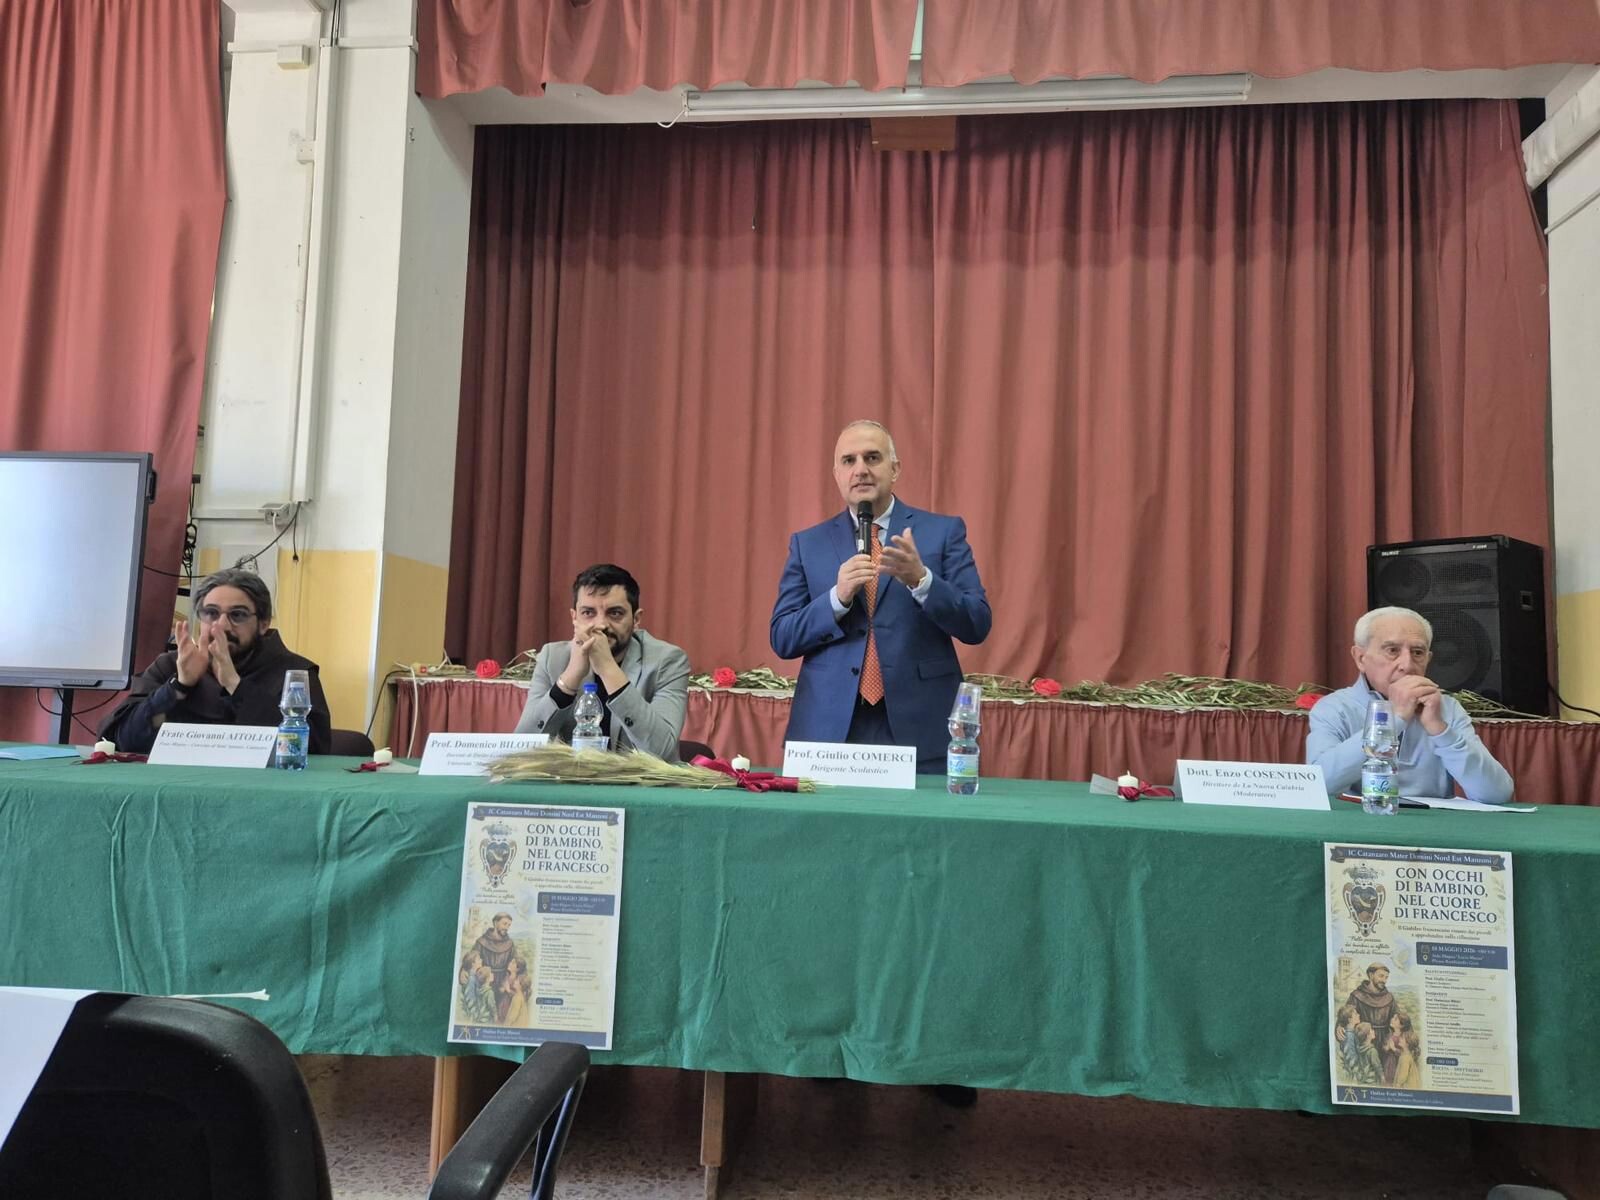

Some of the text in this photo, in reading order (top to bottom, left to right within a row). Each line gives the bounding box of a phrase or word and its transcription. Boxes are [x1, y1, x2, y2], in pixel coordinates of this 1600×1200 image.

[186, 731, 226, 741] Giovanni
[431, 740, 452, 748] Prof.
[454, 740, 498, 749] Domenico
[788, 749, 913, 762] Prof. Giulio COMERCI
[810, 764, 889, 774] Dirigente Scolastico
[1187, 768, 1317, 781] Dott. Enzo COSENTINO
[527, 823, 601, 837] CON OCCHI
[525, 836, 539, 846] DI
[527, 849, 597, 862] NEL CUORE
[1357, 850, 1389, 859] Catanzaro
[1390, 852, 1409, 860] Mater
[1434, 854, 1451, 862] Nord
[523, 861, 610, 874] DI FRANCESCO
[1395, 867, 1483, 883] CON OCCHI
[1395, 881, 1488, 897] DI BAMBINO,
[1399, 894, 1481, 910] NEL CUORE
[1394, 907, 1497, 924] DI FRANCESCO
